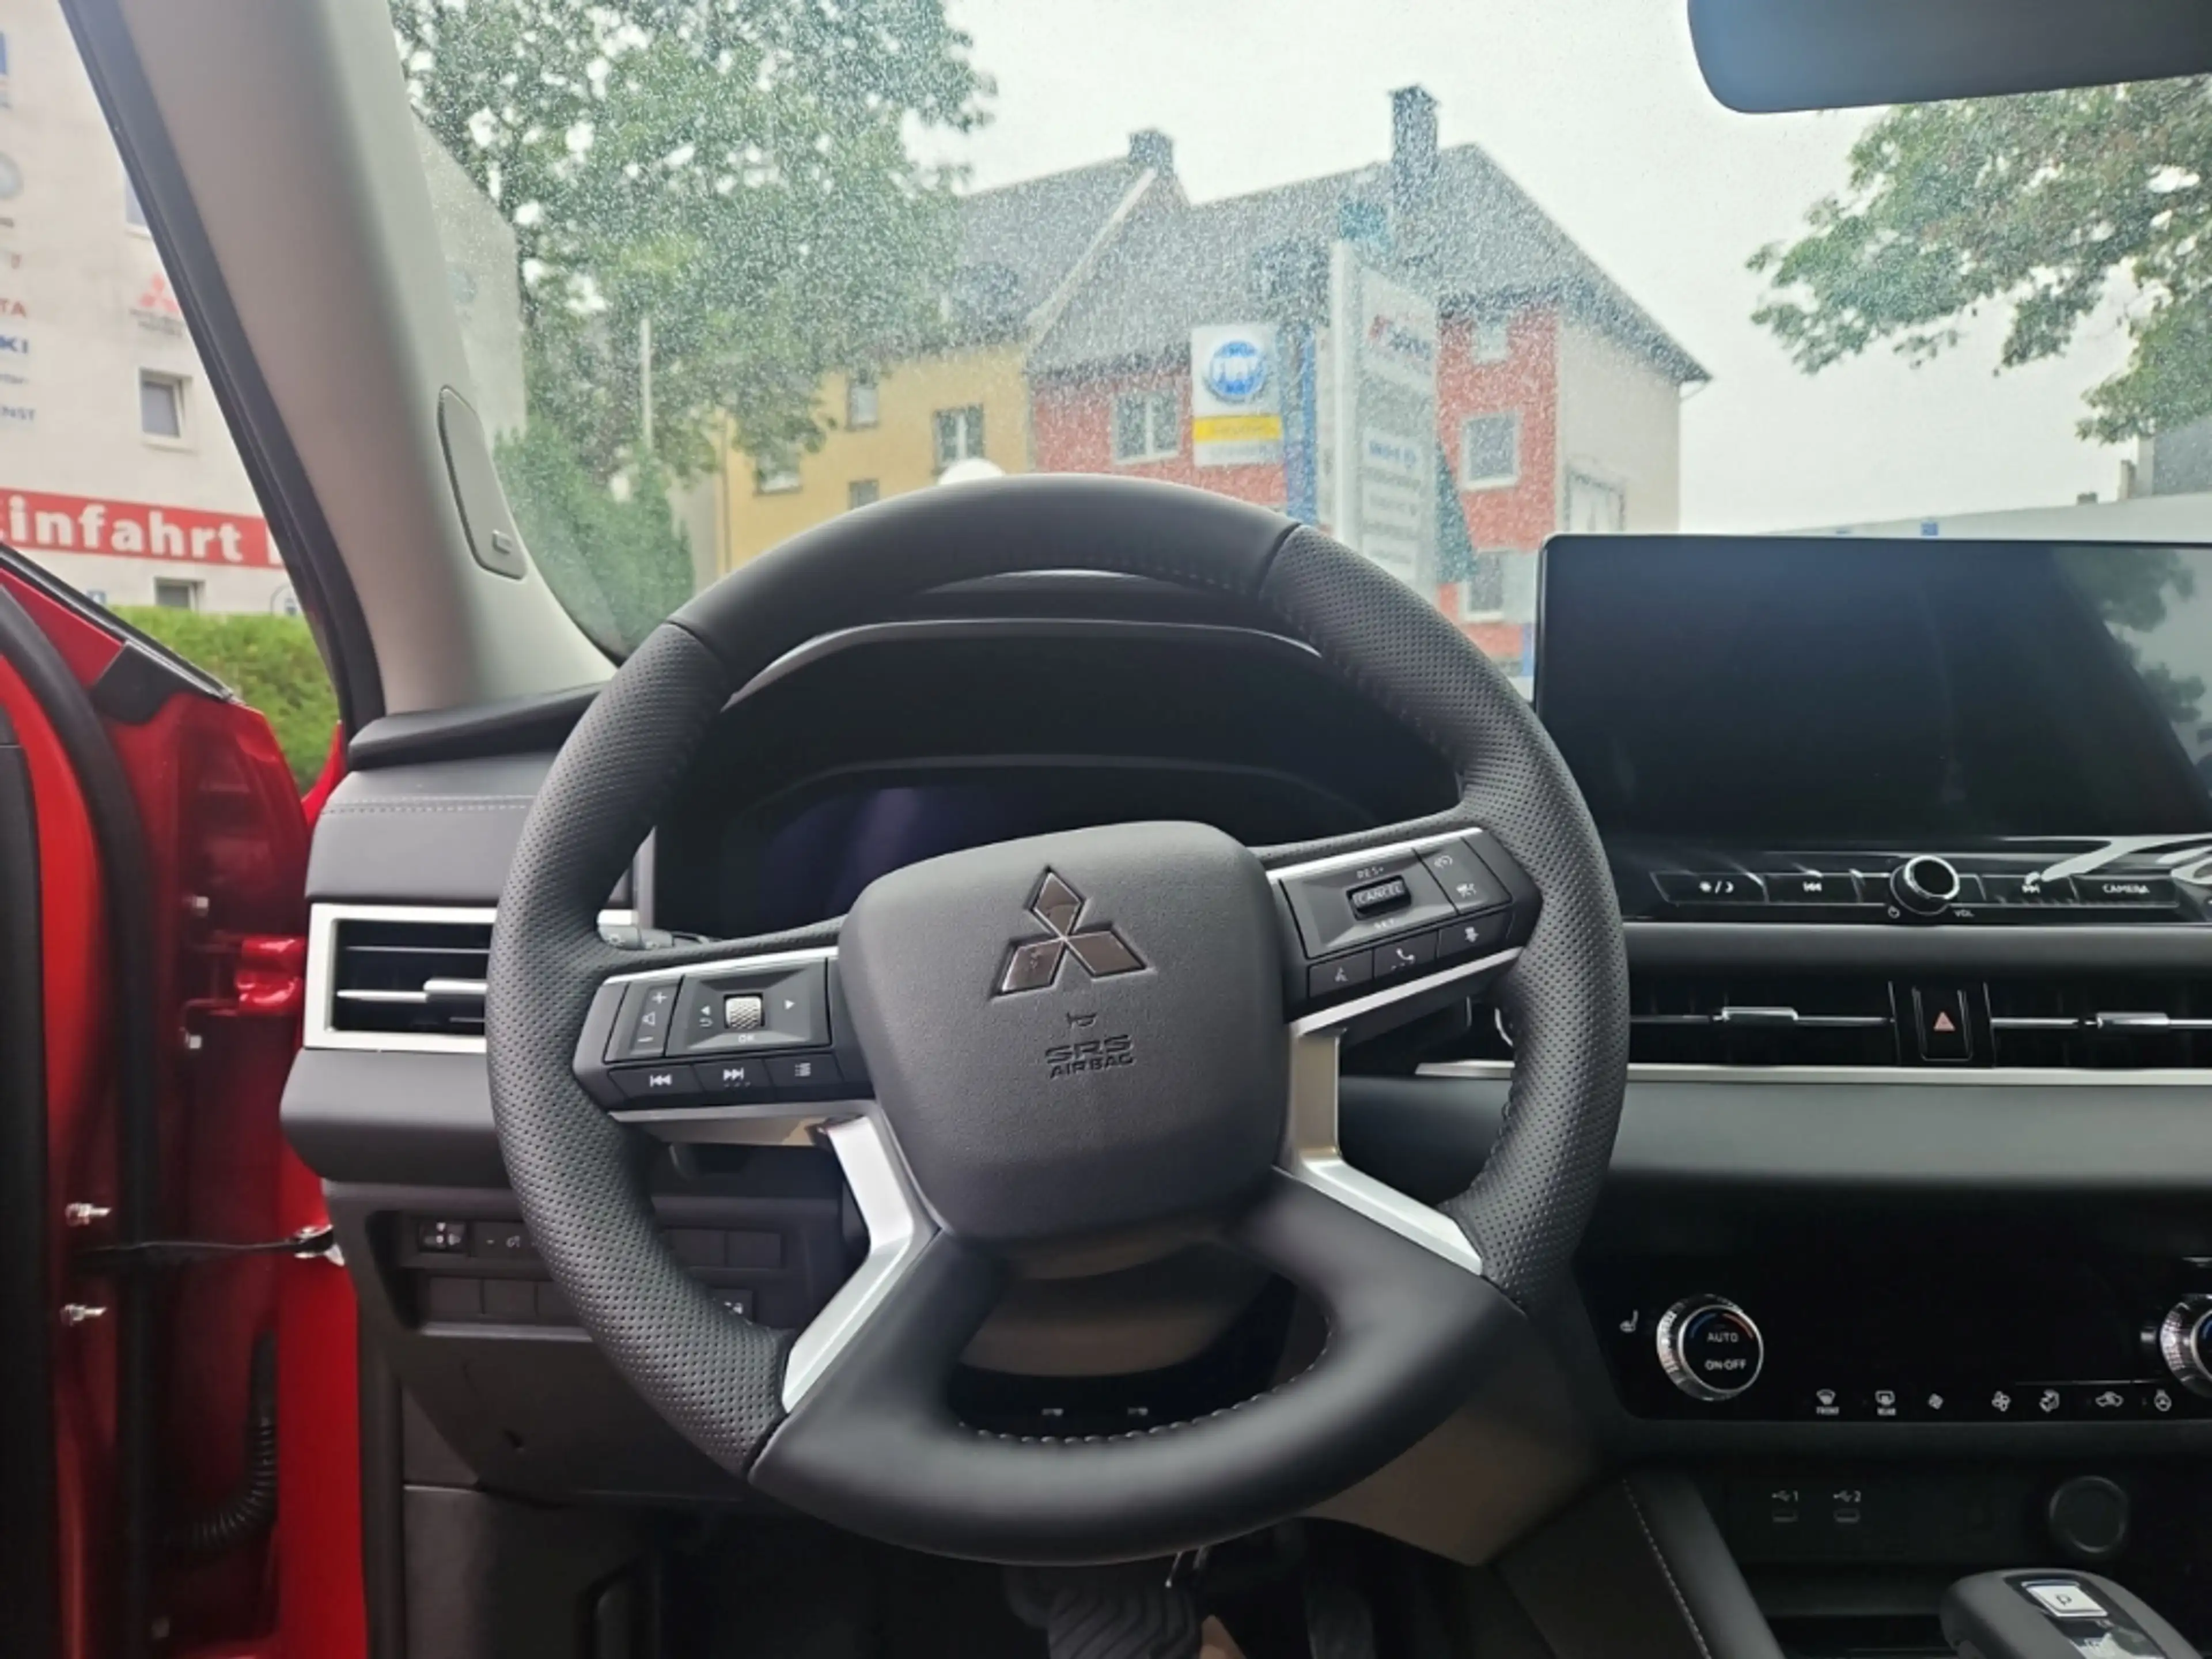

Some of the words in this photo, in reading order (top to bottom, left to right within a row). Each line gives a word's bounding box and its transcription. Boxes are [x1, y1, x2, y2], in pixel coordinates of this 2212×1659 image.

[0, 494, 244, 562] infahrt
[2102, 883, 2150, 894] CAMERA
[738, 1034, 754, 1043] OK
[1046, 1035, 1134, 1063] SRS
[1050, 1052, 1135, 1080] AIRBAG
[1707, 1332, 1739, 1343] AUTO
